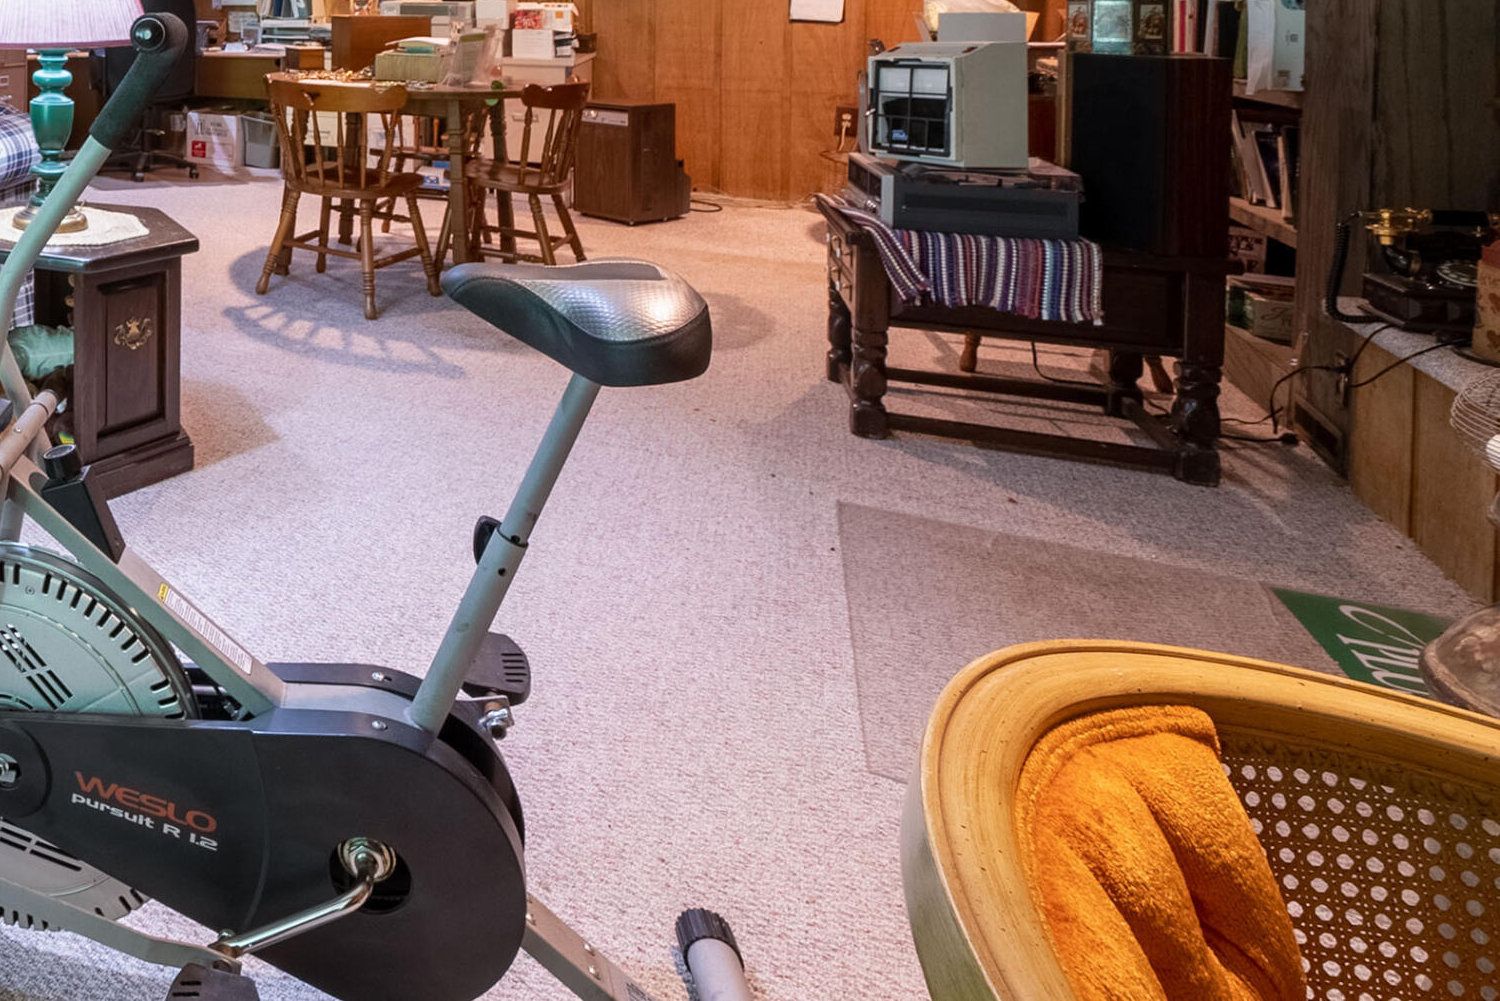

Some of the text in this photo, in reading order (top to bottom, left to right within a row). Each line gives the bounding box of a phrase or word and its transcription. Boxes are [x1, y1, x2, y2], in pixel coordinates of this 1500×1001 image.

[1336, 633, 1431, 696] PLU
[71, 792, 219, 852] pursuit R 1.2
[74, 770, 218, 834] WESLO
